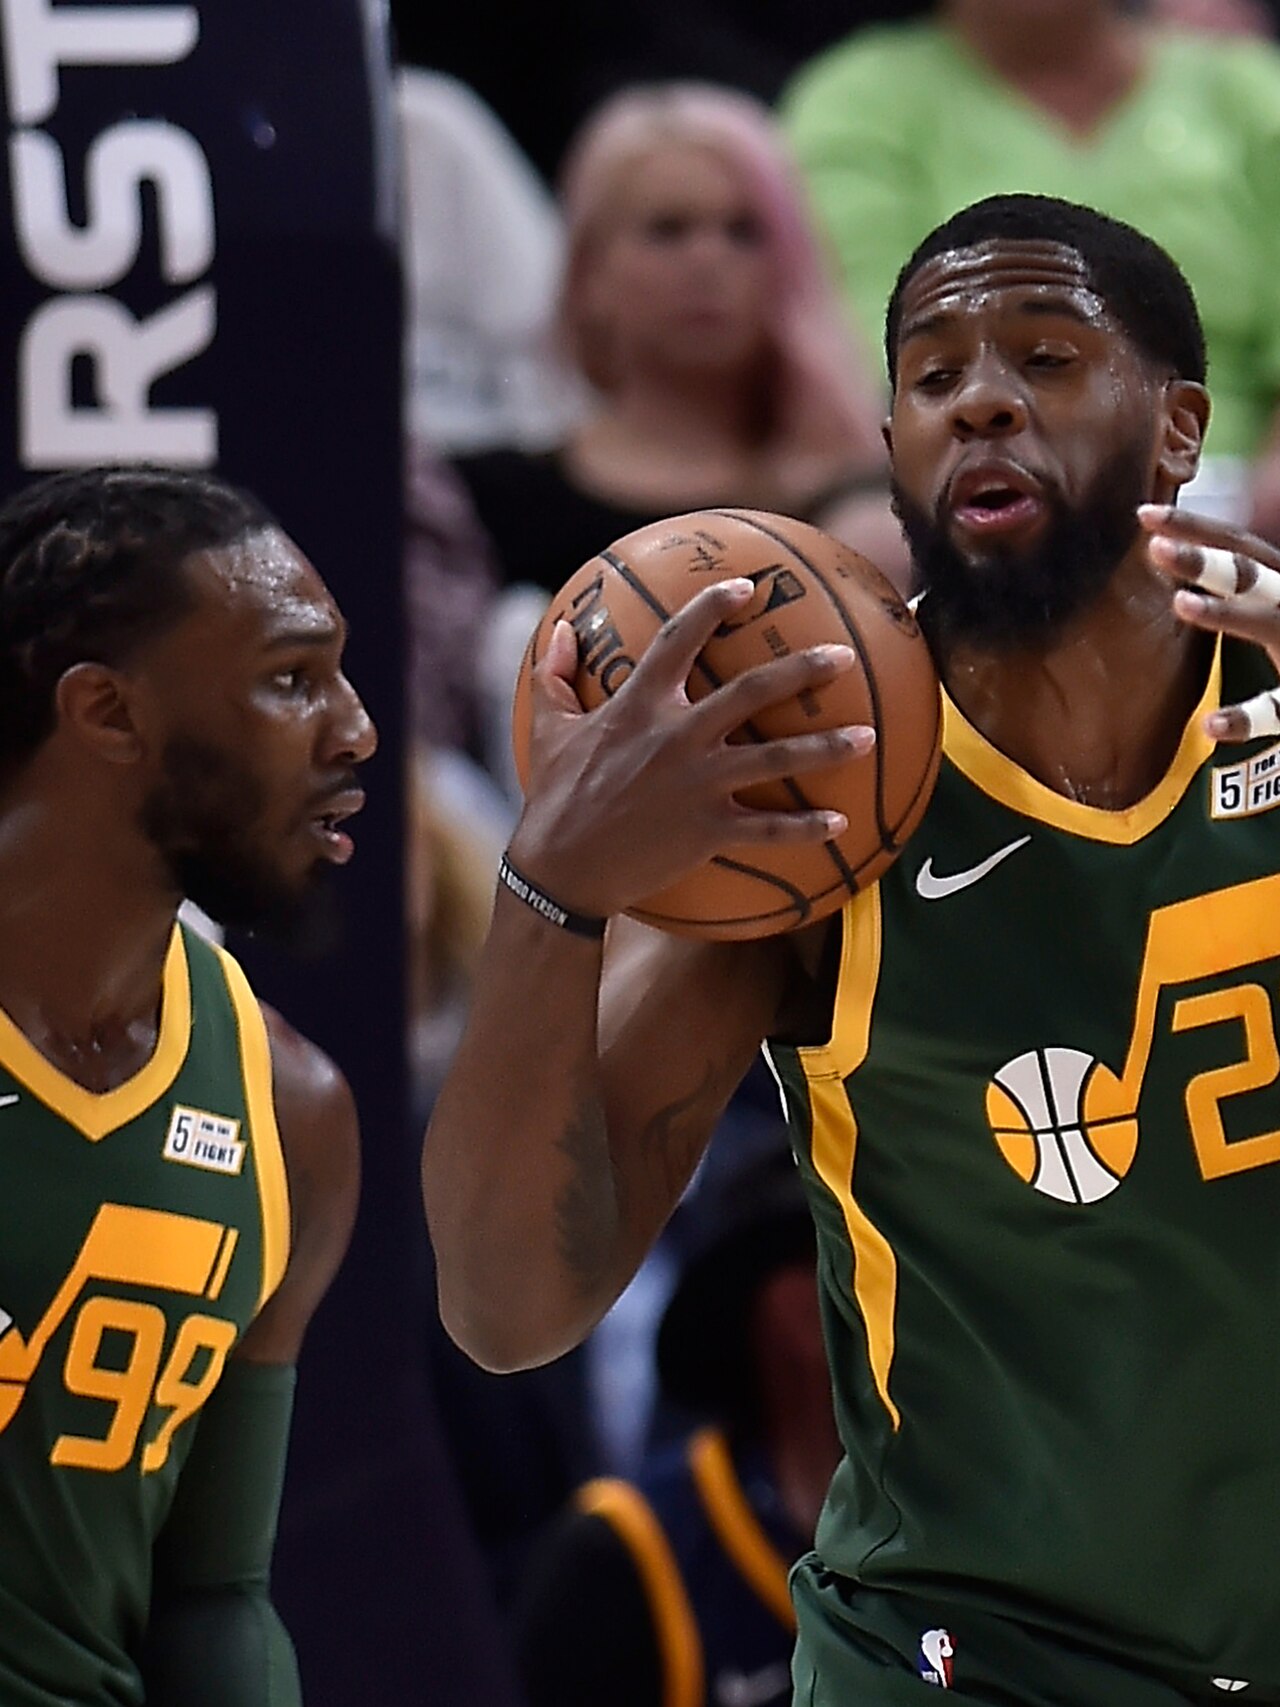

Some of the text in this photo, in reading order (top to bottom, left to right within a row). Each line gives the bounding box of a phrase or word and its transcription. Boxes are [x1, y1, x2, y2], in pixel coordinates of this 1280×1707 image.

[1254, 754, 1276, 775] FOR
[1220, 770, 1241, 810] 5
[173, 1115, 191, 1152] 5
[195, 1141, 234, 1164] FIGHT
[51, 1296, 237, 1475] 99
